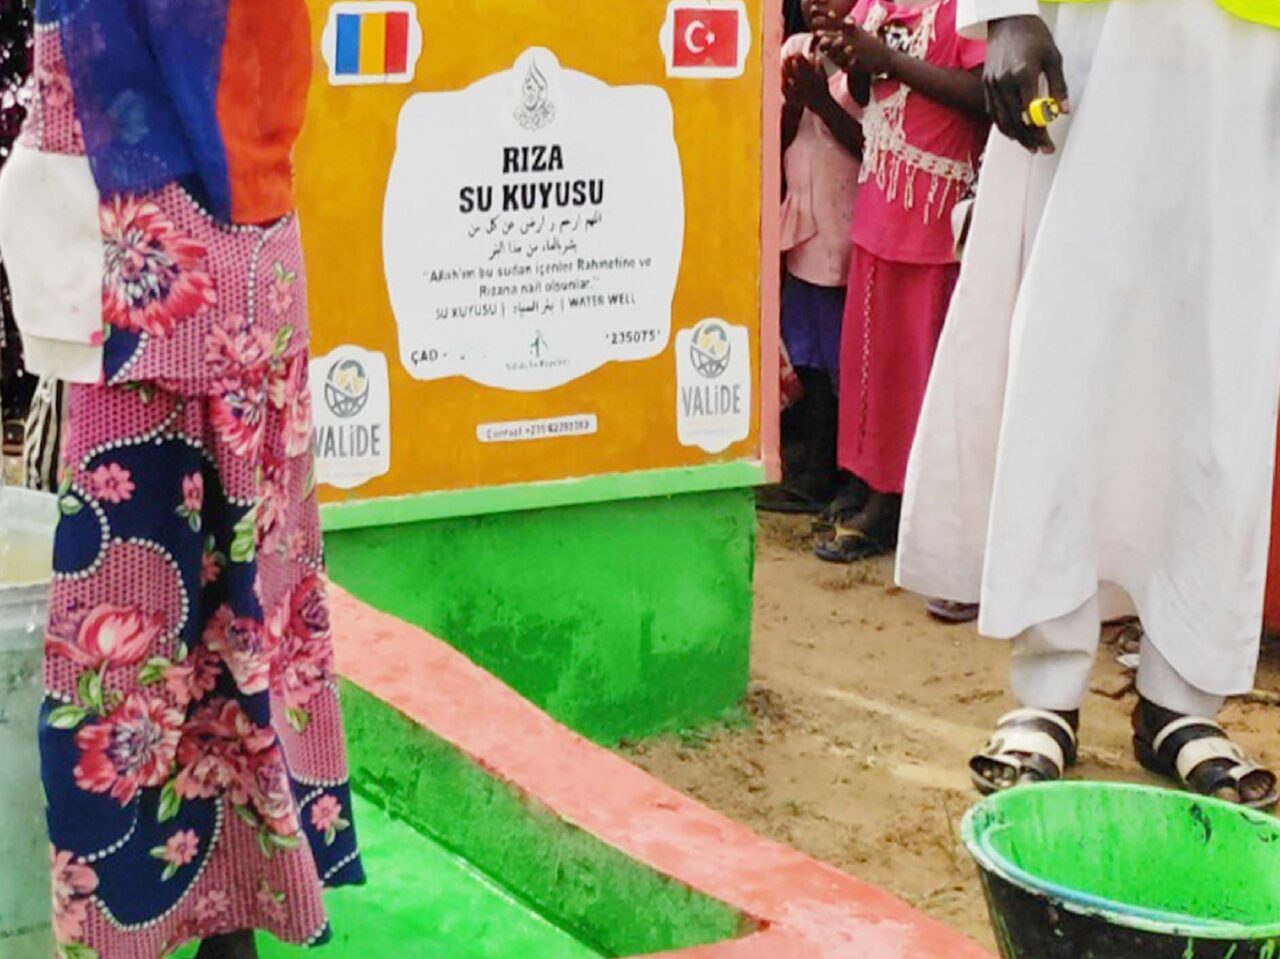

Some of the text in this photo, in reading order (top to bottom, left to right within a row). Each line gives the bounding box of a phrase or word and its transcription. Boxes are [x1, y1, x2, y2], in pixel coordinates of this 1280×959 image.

[502, 144, 564, 174] RIZA
[459, 178, 604, 214] SU KUYUSU
[479, 266, 494, 279] bu
[497, 264, 532, 277] sudan
[577, 257, 636, 271] Rahmetine
[638, 257, 651, 268] ve
[435, 306, 448, 320] SU
[452, 302, 498, 319] KUYUSU
[568, 294, 605, 309] WATER
[607, 292, 636, 306] WELL
[410, 348, 439, 367] ÇAD
